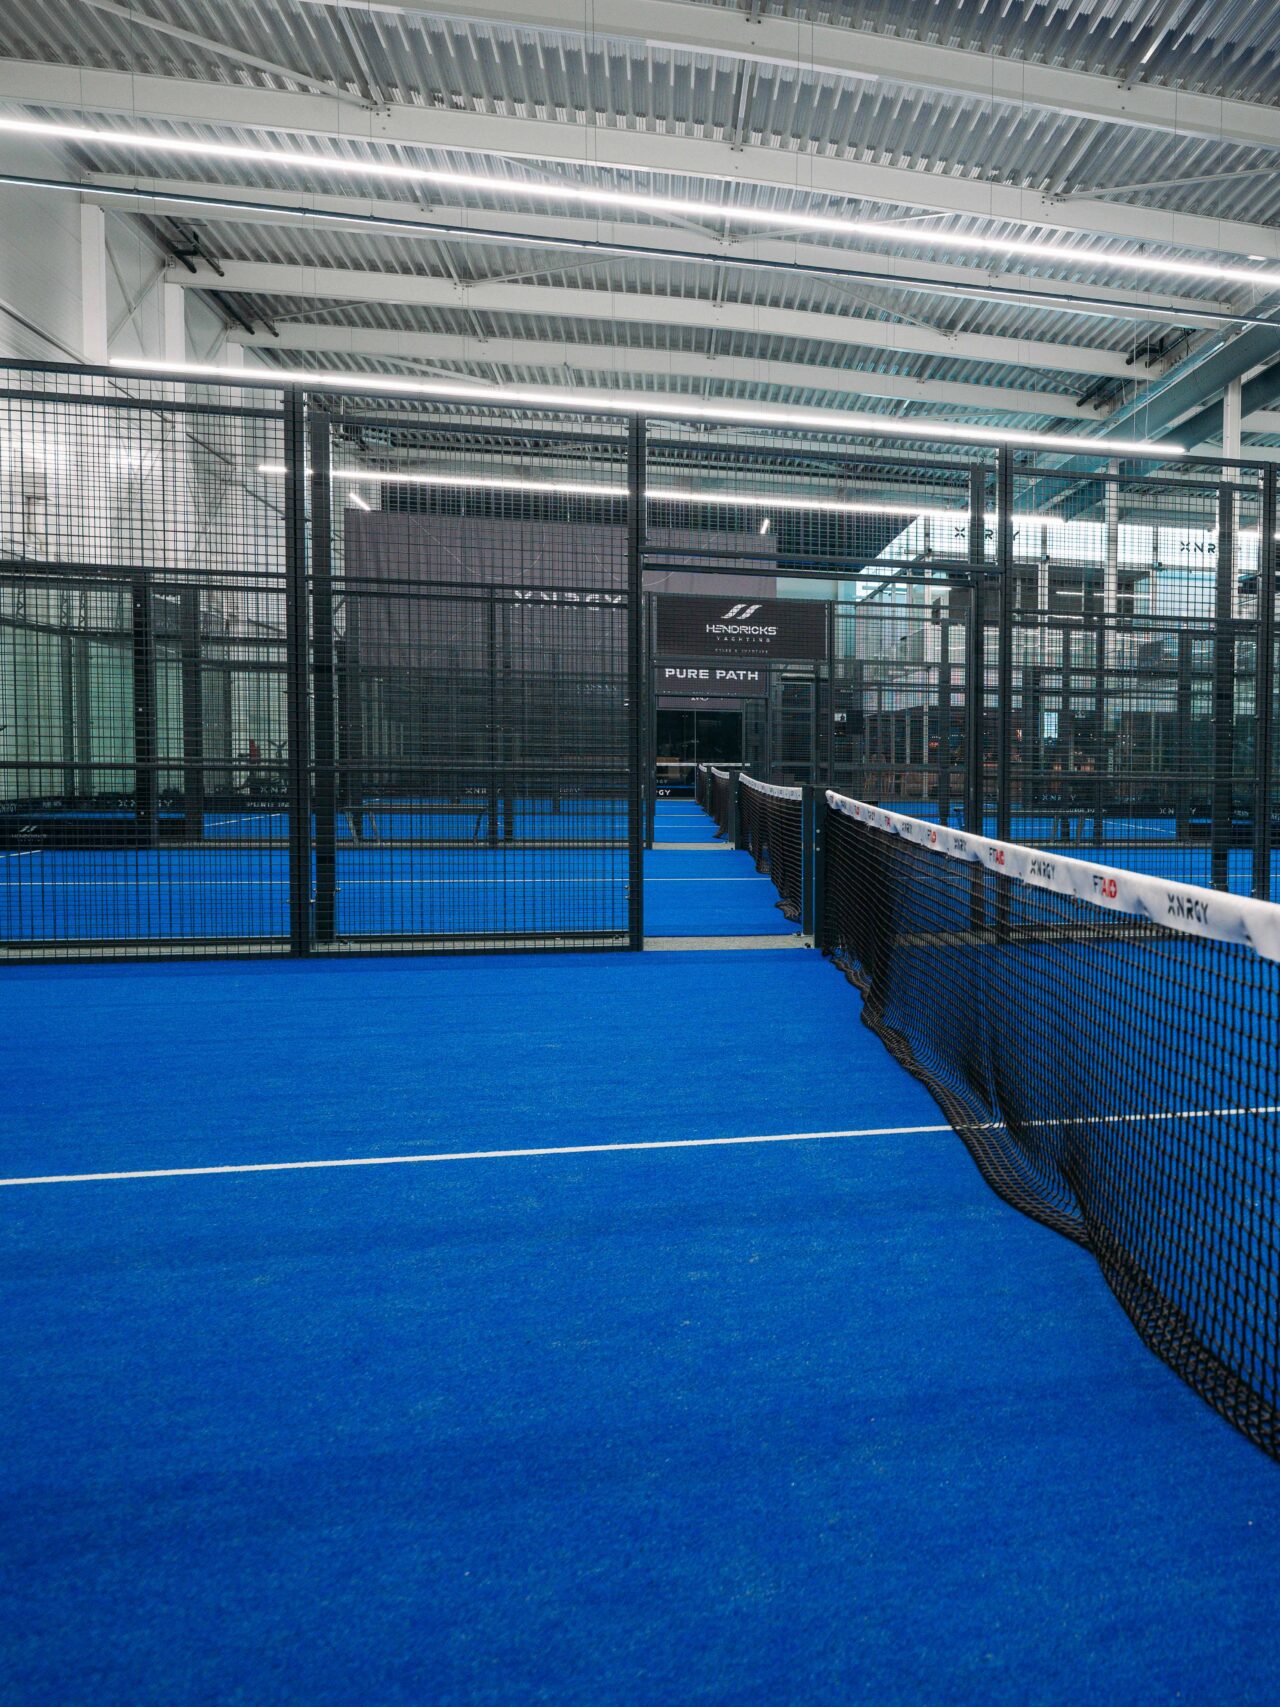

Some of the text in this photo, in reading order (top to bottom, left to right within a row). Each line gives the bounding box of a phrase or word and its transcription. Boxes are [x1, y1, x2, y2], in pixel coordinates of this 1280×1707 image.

[705, 624, 778, 636] HENDRICKS
[664, 668, 759, 681] PURE PATH
[1166, 893, 1209, 924] XNRGY
